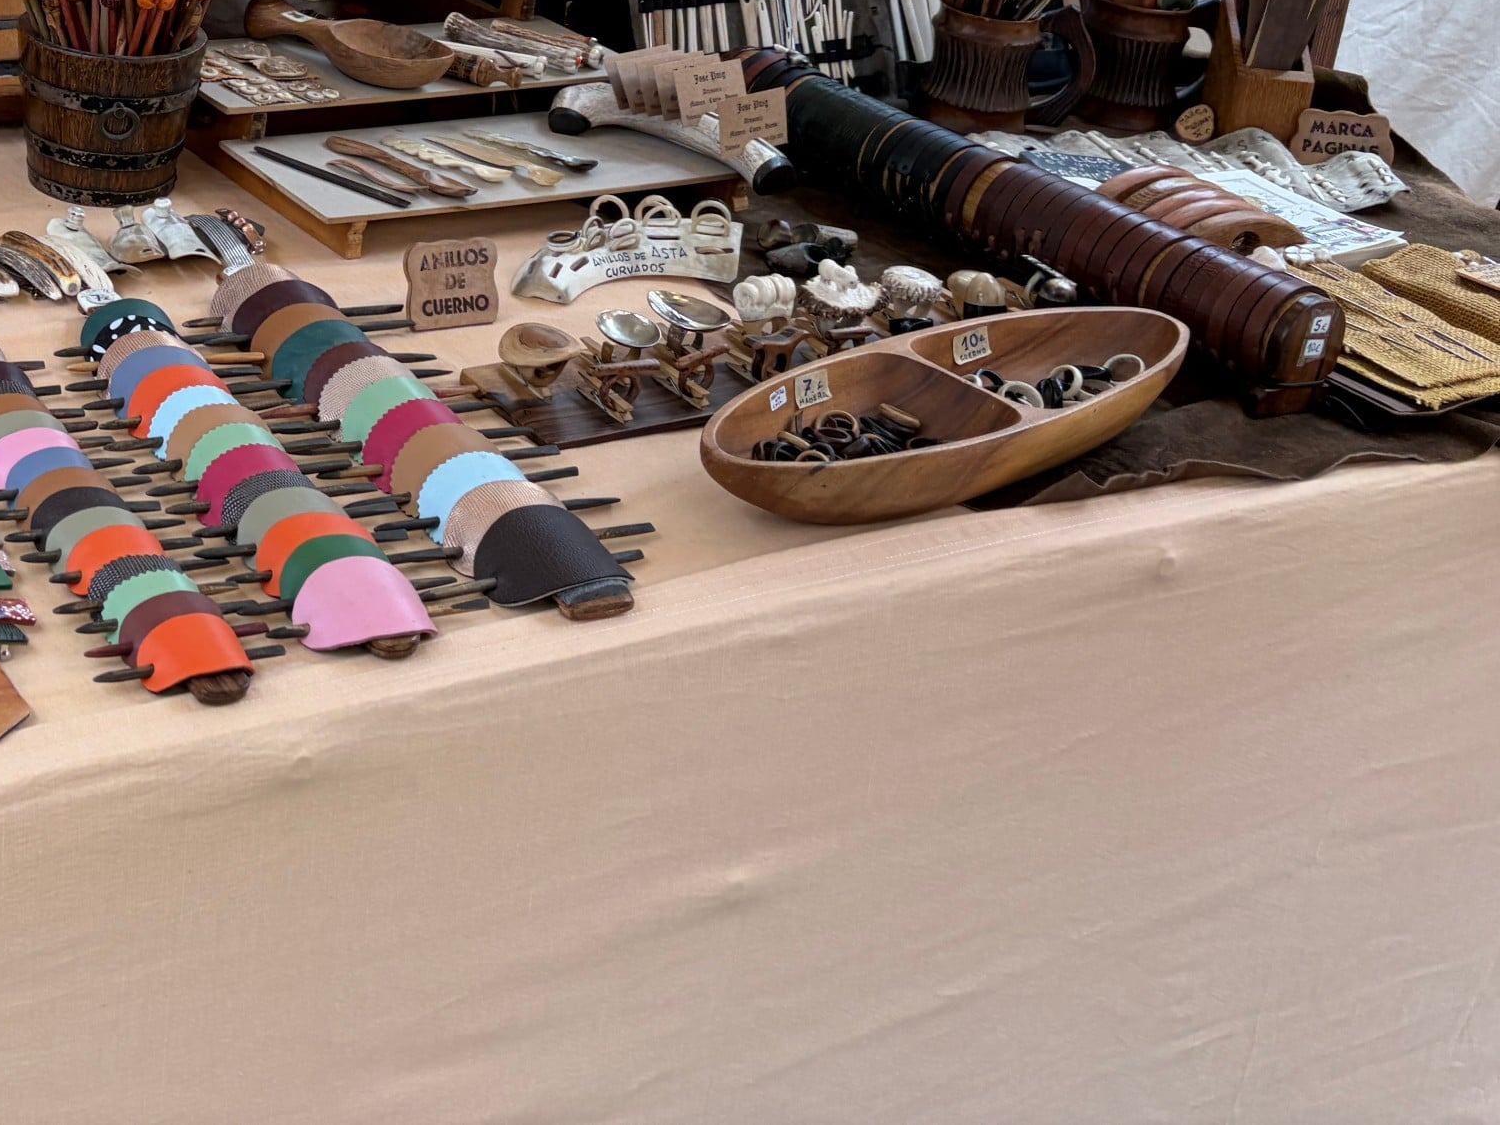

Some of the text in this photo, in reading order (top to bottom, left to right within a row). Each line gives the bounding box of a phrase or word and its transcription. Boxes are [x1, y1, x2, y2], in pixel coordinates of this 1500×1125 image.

[1310, 120, 1374, 137] MARCA
[421, 248, 489, 271] ANILLOS
[593, 246, 688, 266] ANILLOS DE ASTA
[606, 263, 665, 277] CURVADOS
[445, 272, 466, 290] DE
[422, 294, 489, 316] CUERNO
